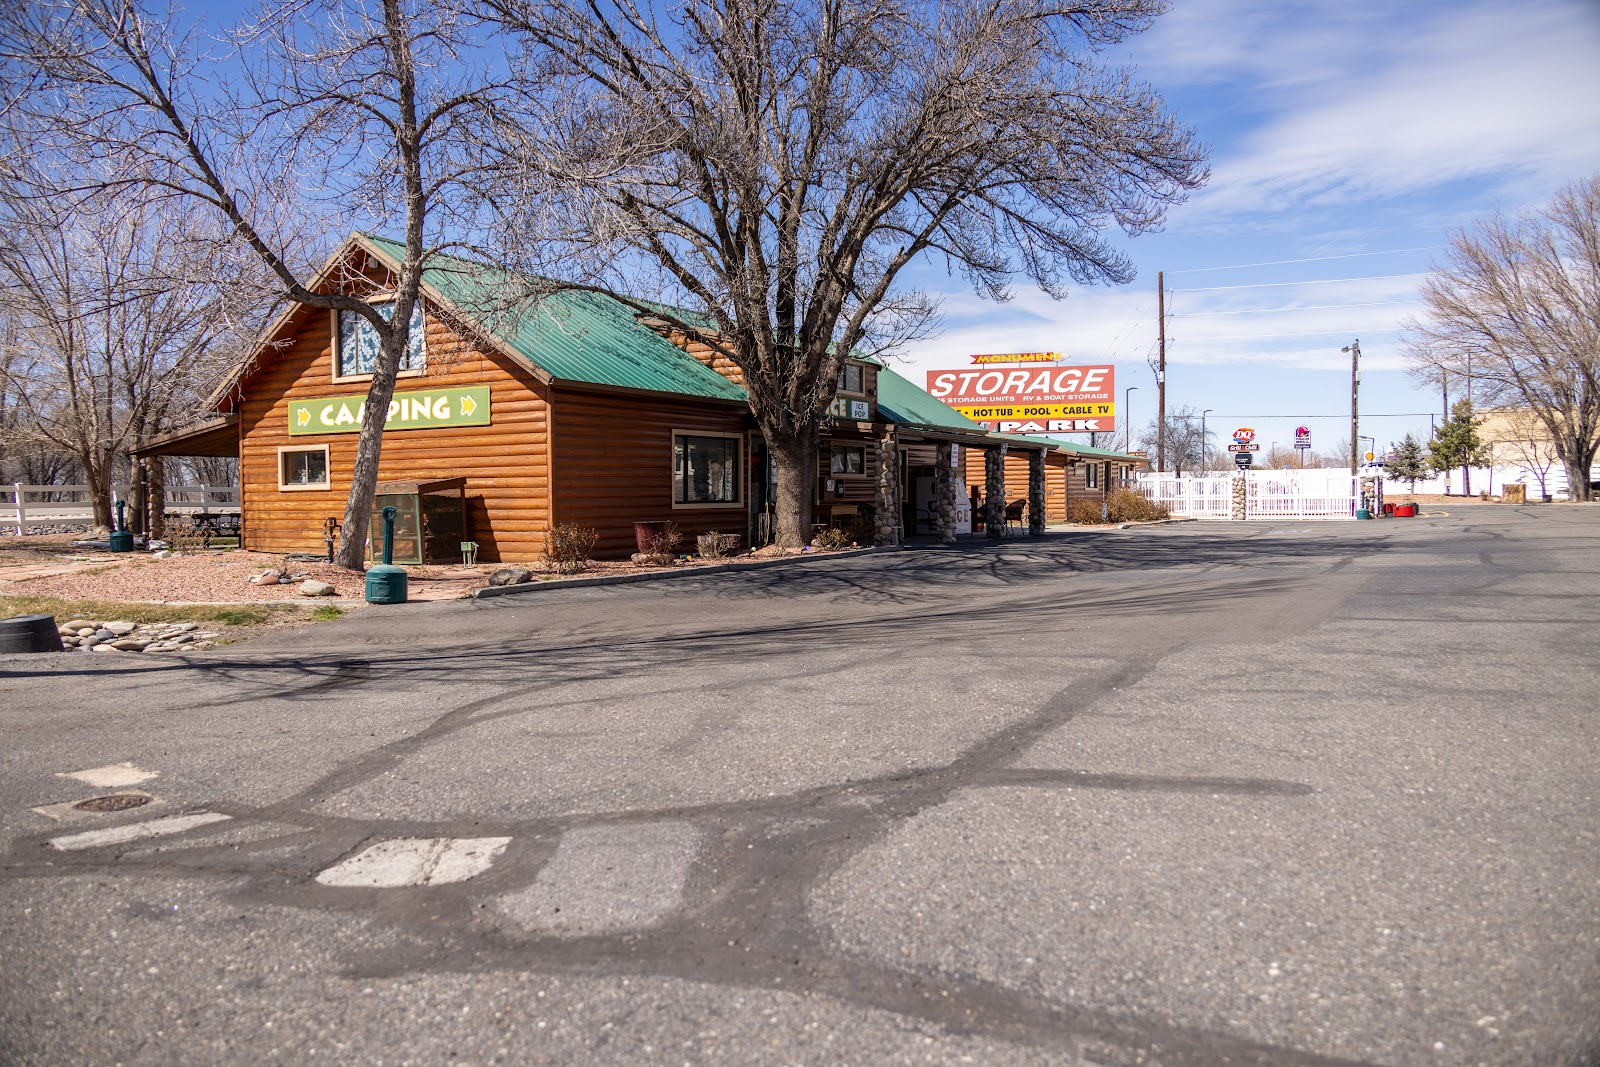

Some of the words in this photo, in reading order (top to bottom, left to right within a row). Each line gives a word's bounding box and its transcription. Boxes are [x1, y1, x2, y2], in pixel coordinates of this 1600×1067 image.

[977, 353, 1061, 363] MONUMENT
[931, 369, 1108, 396] STORAGE
[320, 396, 450, 426] CAPING
[854, 410, 866, 418] POP
[973, 409, 994, 417] HOT
[995, 408, 1013, 416] TUB
[1024, 407, 1051, 416] POOL
[1062, 406, 1092, 415] CABLE
[1097, 405, 1109, 414] TV
[1000, 420, 1100, 432] PARK
[1236, 430, 1251, 439] DQ
